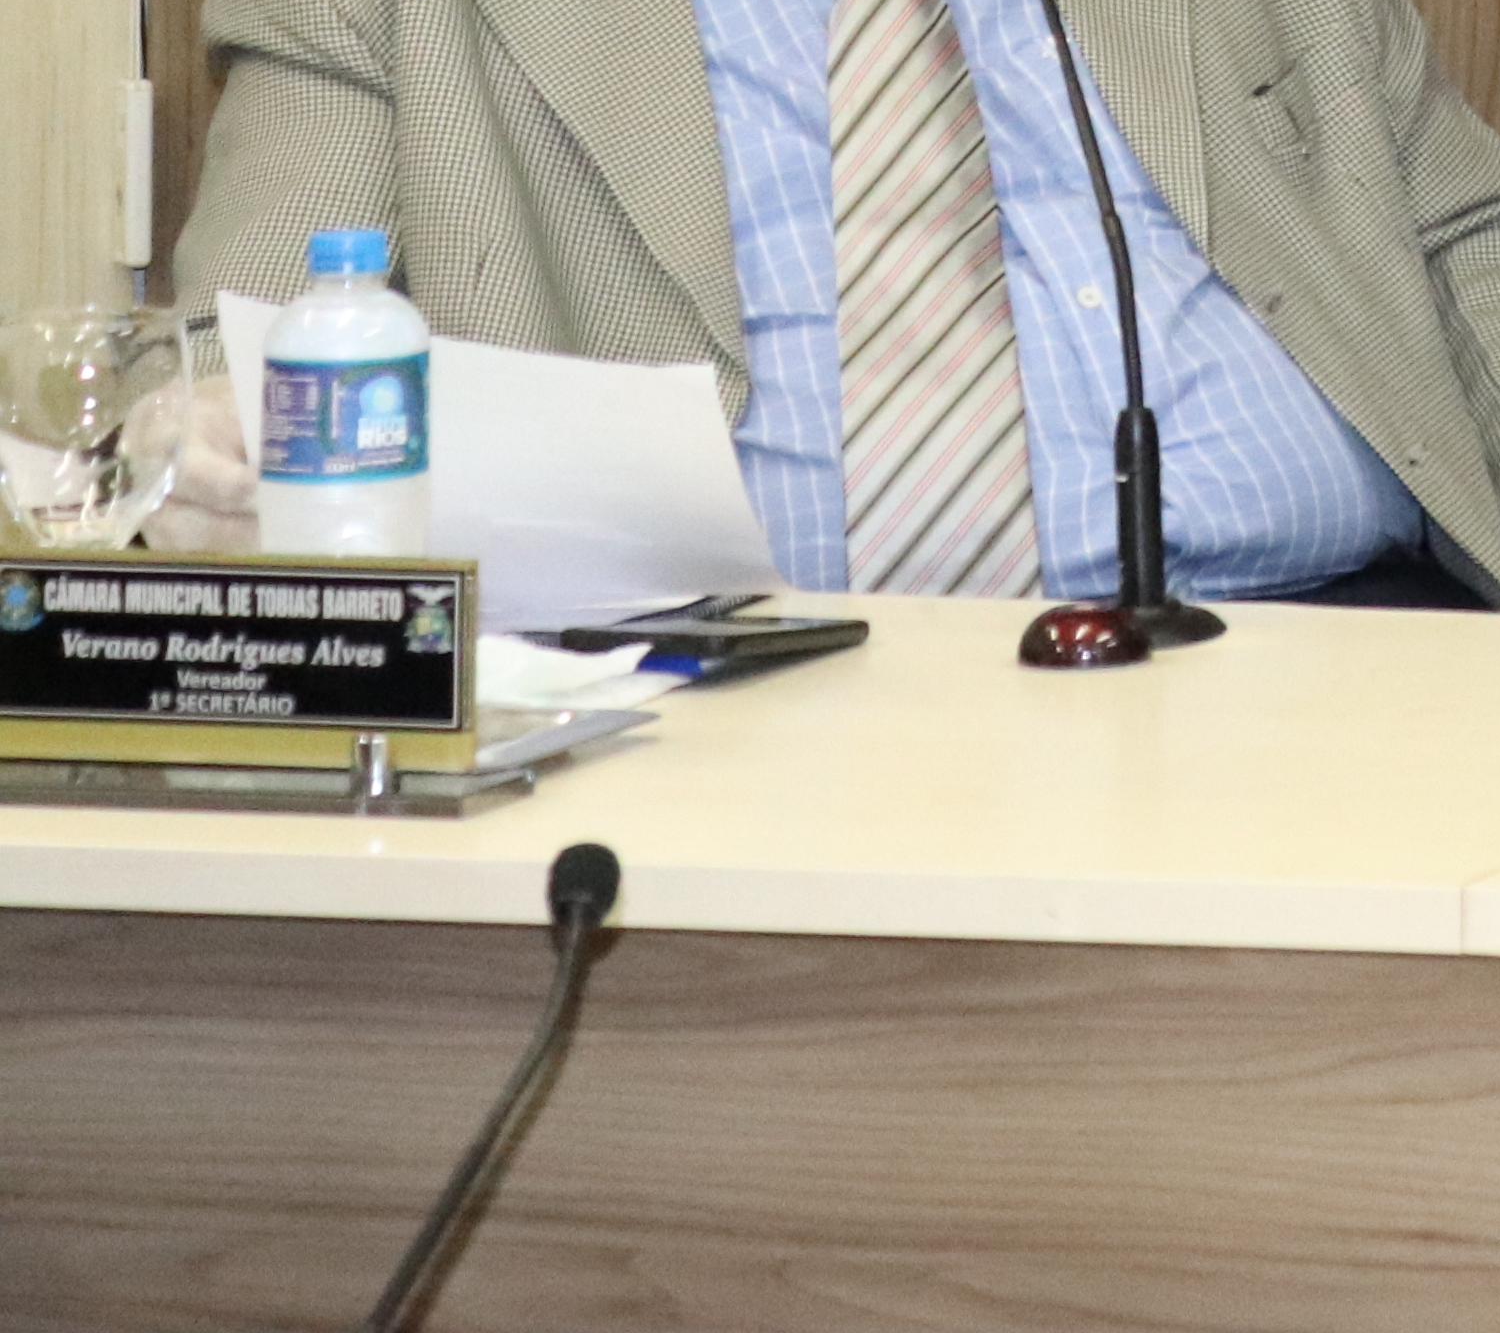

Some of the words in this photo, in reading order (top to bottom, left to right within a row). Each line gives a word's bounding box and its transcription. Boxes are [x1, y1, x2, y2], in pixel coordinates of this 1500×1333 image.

[44, 575, 122, 613] CÂMARA
[125, 579, 224, 616] MUNICIPAL
[227, 584, 251, 617] DE
[256, 585, 320, 619] TOBIAS
[322, 586, 404, 622] BARRETO
[61, 629, 158, 661] Verano
[166, 633, 303, 670] Rodrigues
[310, 638, 386, 668] Alves
[177, 669, 267, 691] Vereador
[175, 690, 294, 716] SECRETÁRIO
